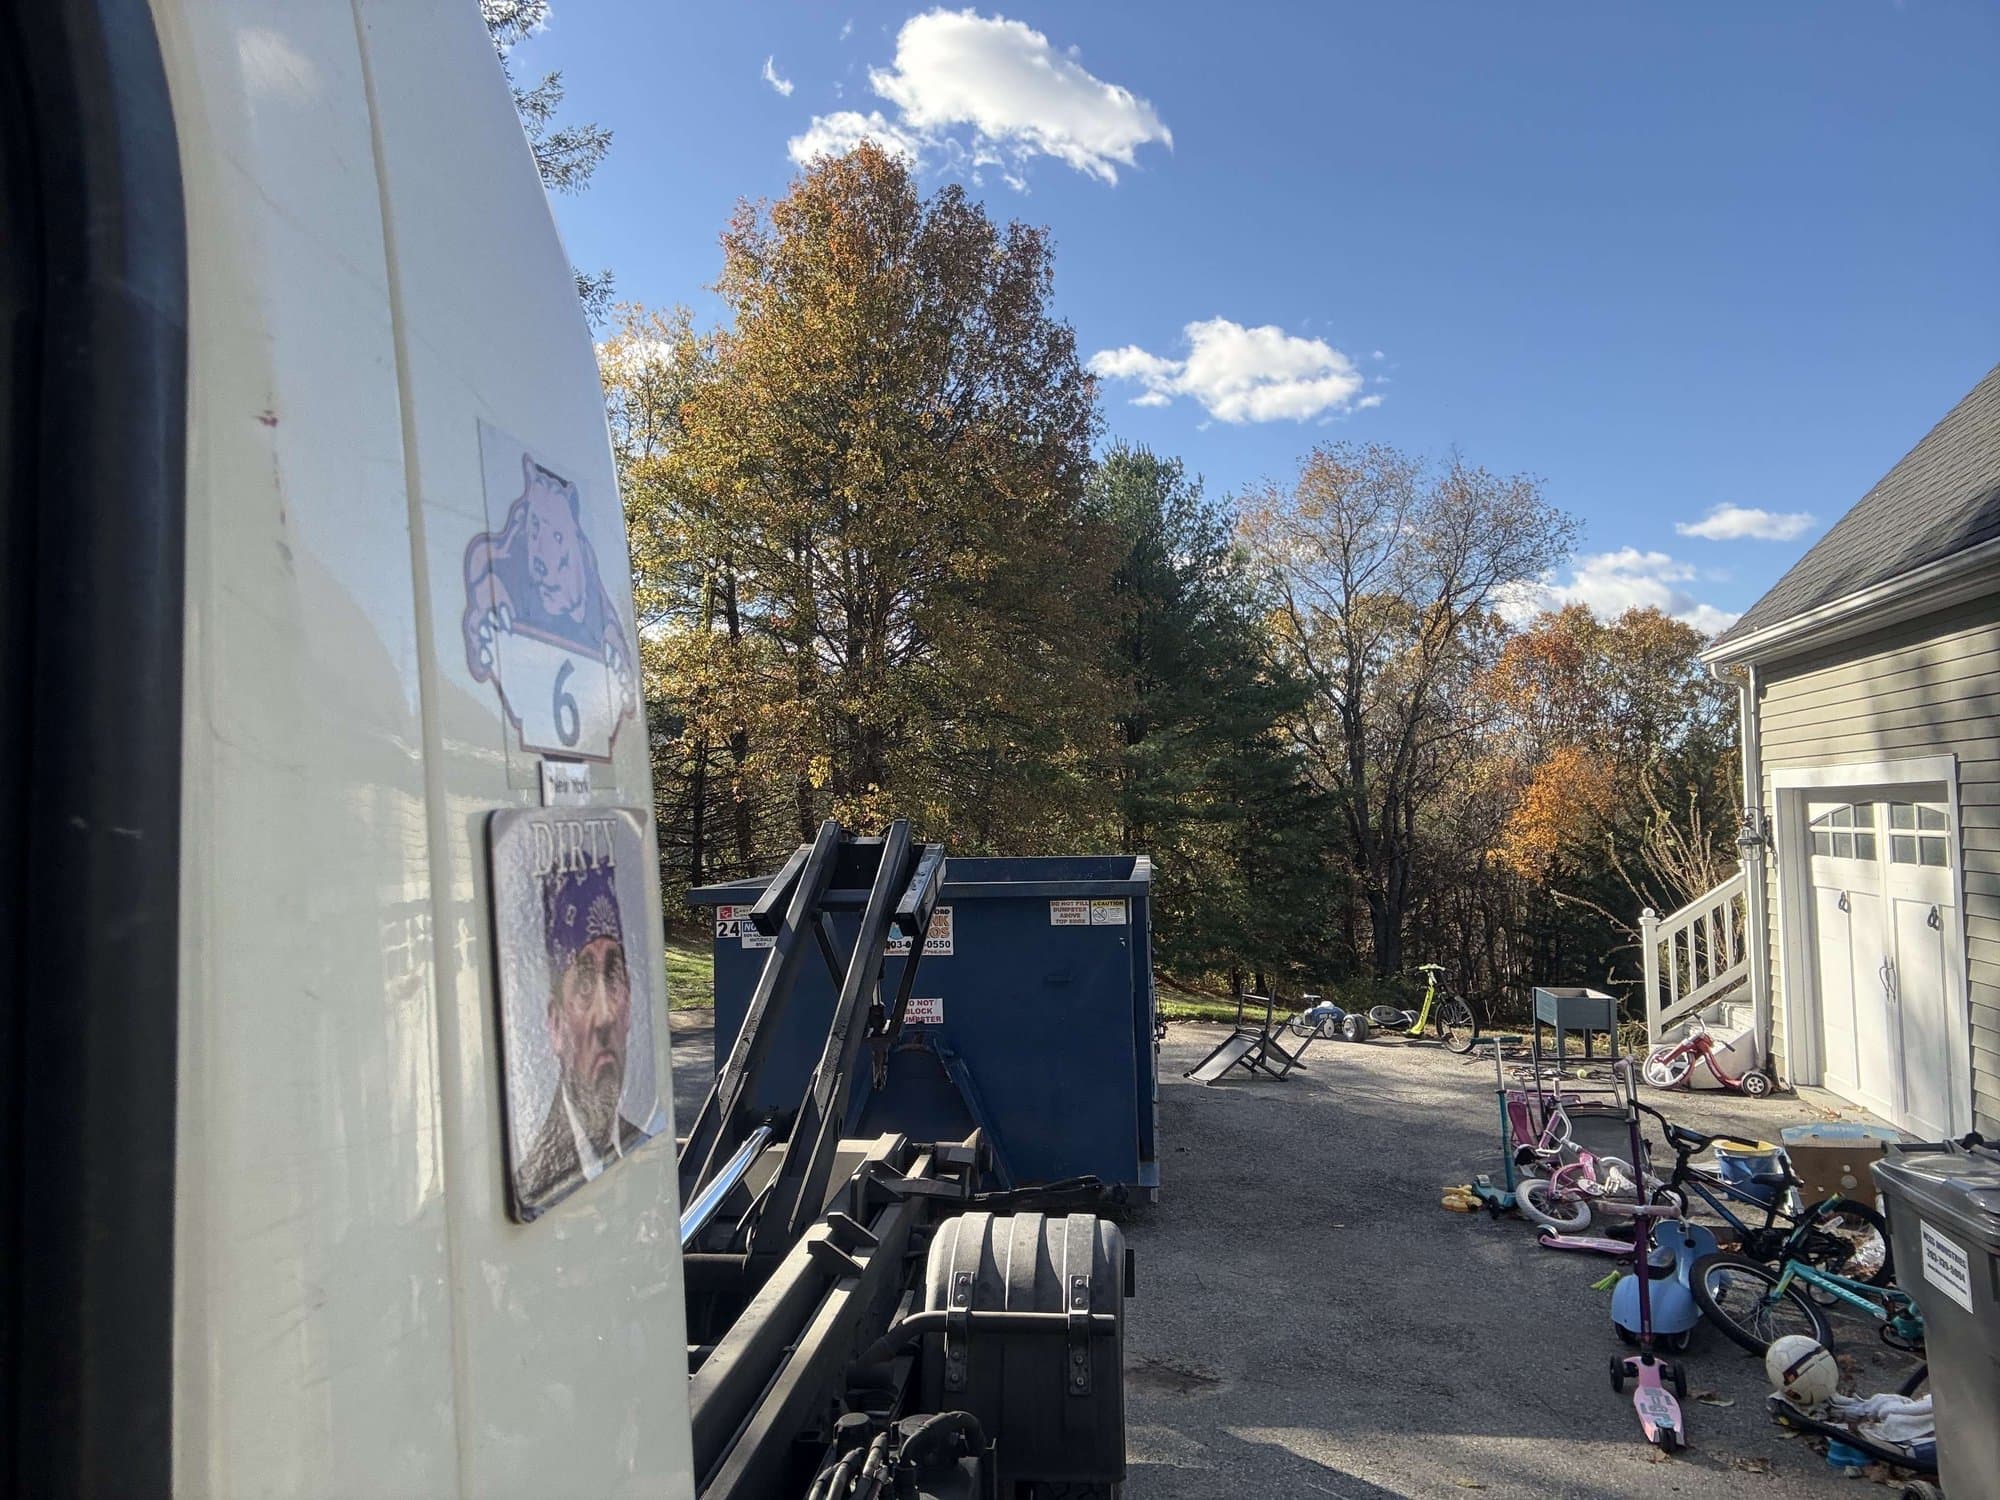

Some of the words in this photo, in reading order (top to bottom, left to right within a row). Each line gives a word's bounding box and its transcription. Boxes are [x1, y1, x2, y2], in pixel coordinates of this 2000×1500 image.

[553, 659, 580, 747] 6
[531, 818, 617, 878] DIRTY
[932, 916, 949, 927] NK
[718, 922, 740, 937] 24
[928, 927, 950, 938] OS
